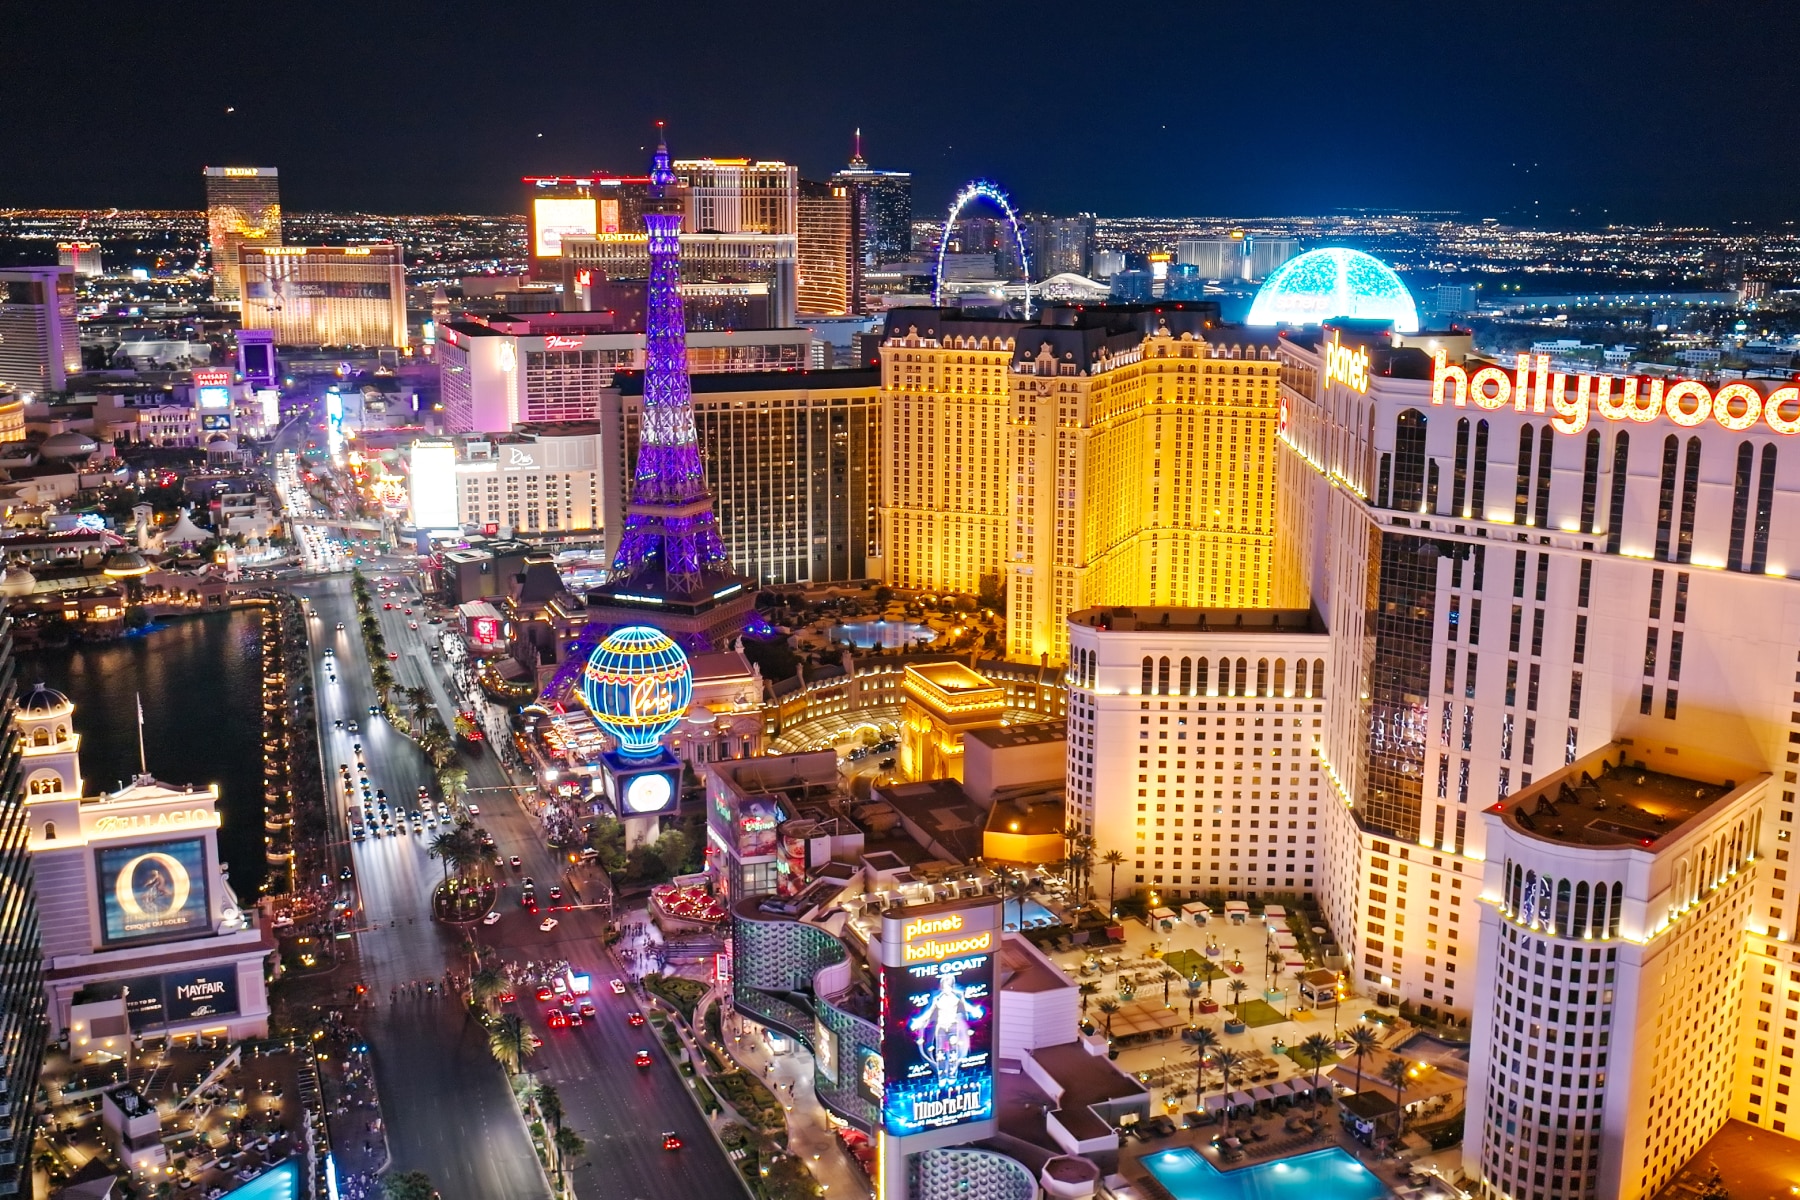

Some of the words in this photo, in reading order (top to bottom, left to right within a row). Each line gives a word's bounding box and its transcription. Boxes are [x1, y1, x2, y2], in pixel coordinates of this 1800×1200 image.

[225, 168, 258, 177] TRUMP
[597, 233, 649, 242] VENETIAN
[264, 247, 307, 255] TREASURE
[345, 247, 370, 255] ISLAND
[545, 336, 583, 349] Flamingo
[1325, 329, 1369, 394] planet
[632, 677, 673, 724] Paris
[96, 808, 209, 832] BELLAGIO
[115, 852, 191, 918] O
[124, 923, 151, 932] CIRQUE
[152, 919, 163, 927] DU
[164, 917, 188, 926] SOLEIL
[905, 915, 962, 941] planet
[906, 933, 990, 960] hollywood
[177, 981, 225, 999] MAYFAIR
[913, 1091, 981, 1121] MINDFREAK
